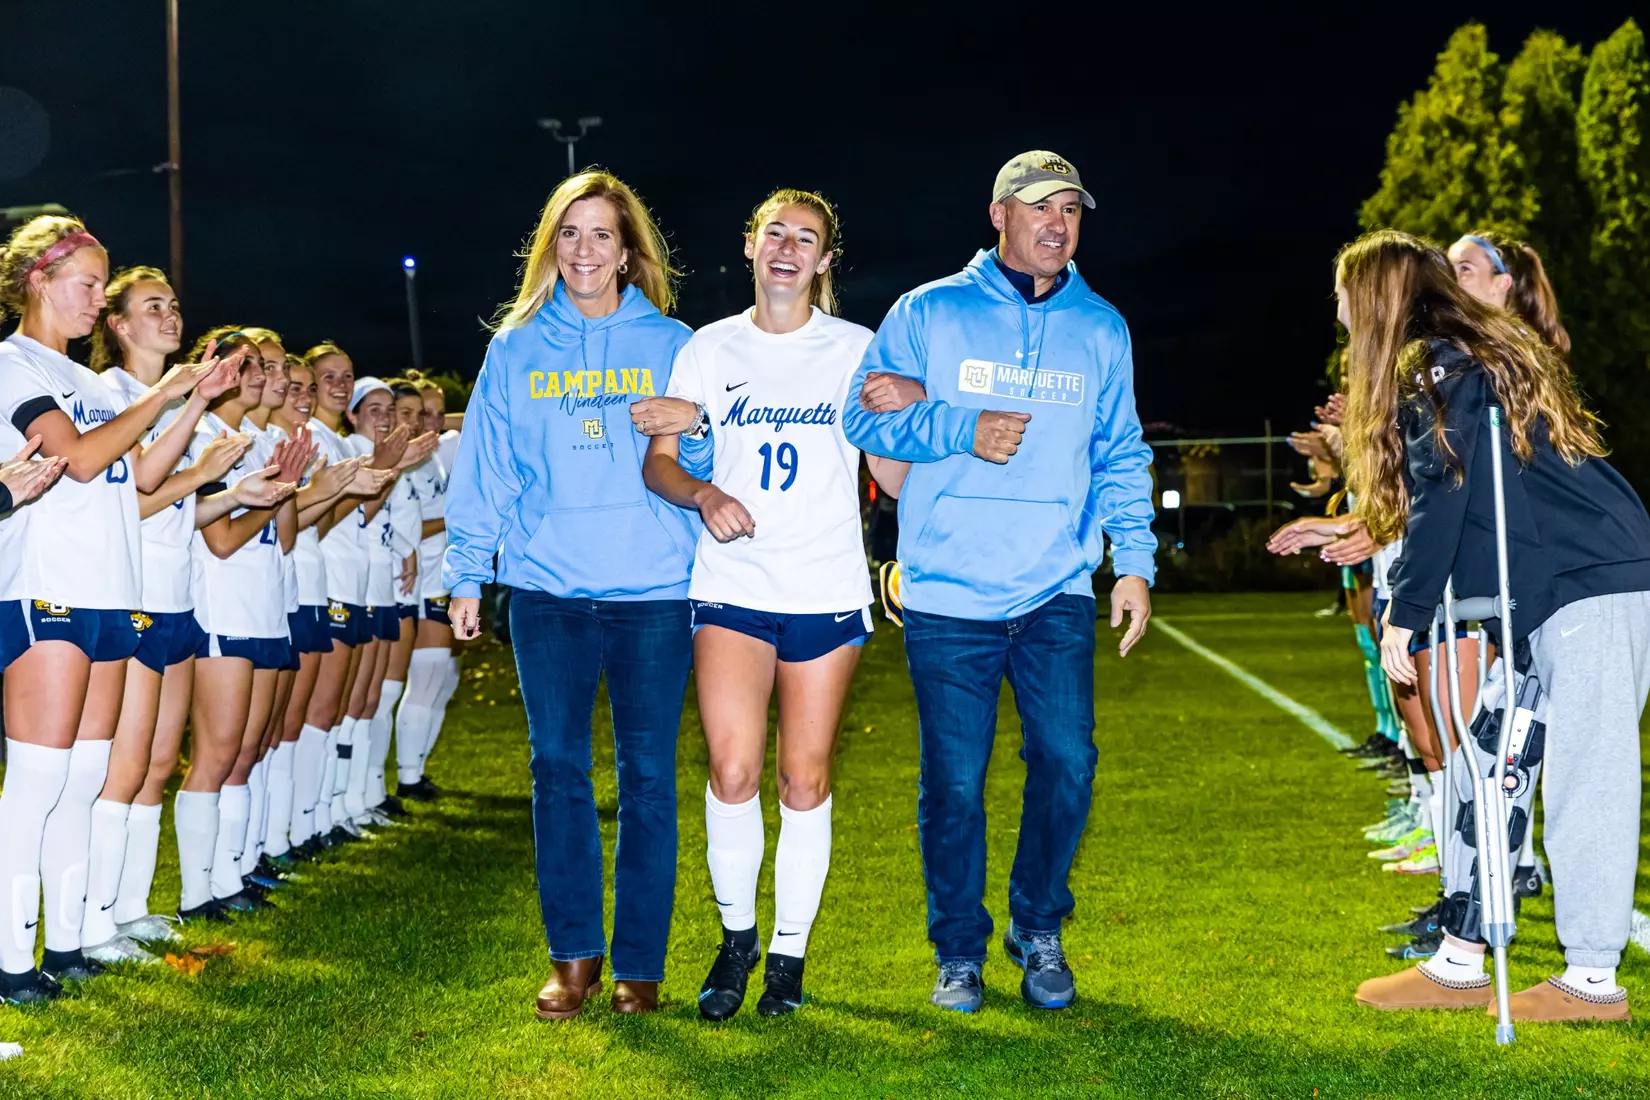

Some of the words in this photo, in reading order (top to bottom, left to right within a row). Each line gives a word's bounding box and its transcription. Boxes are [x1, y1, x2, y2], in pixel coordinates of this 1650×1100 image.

[529, 368, 656, 399] CAMPANA
[964, 365, 988, 388] MU
[997, 366, 1080, 392] MARQUETTE
[559, 389, 627, 416] Nineteen
[720, 395, 836, 433] Marquette
[582, 418, 605, 440] MU
[572, 443, 614, 451] SOCCER
[758, 442, 798, 492] 19
